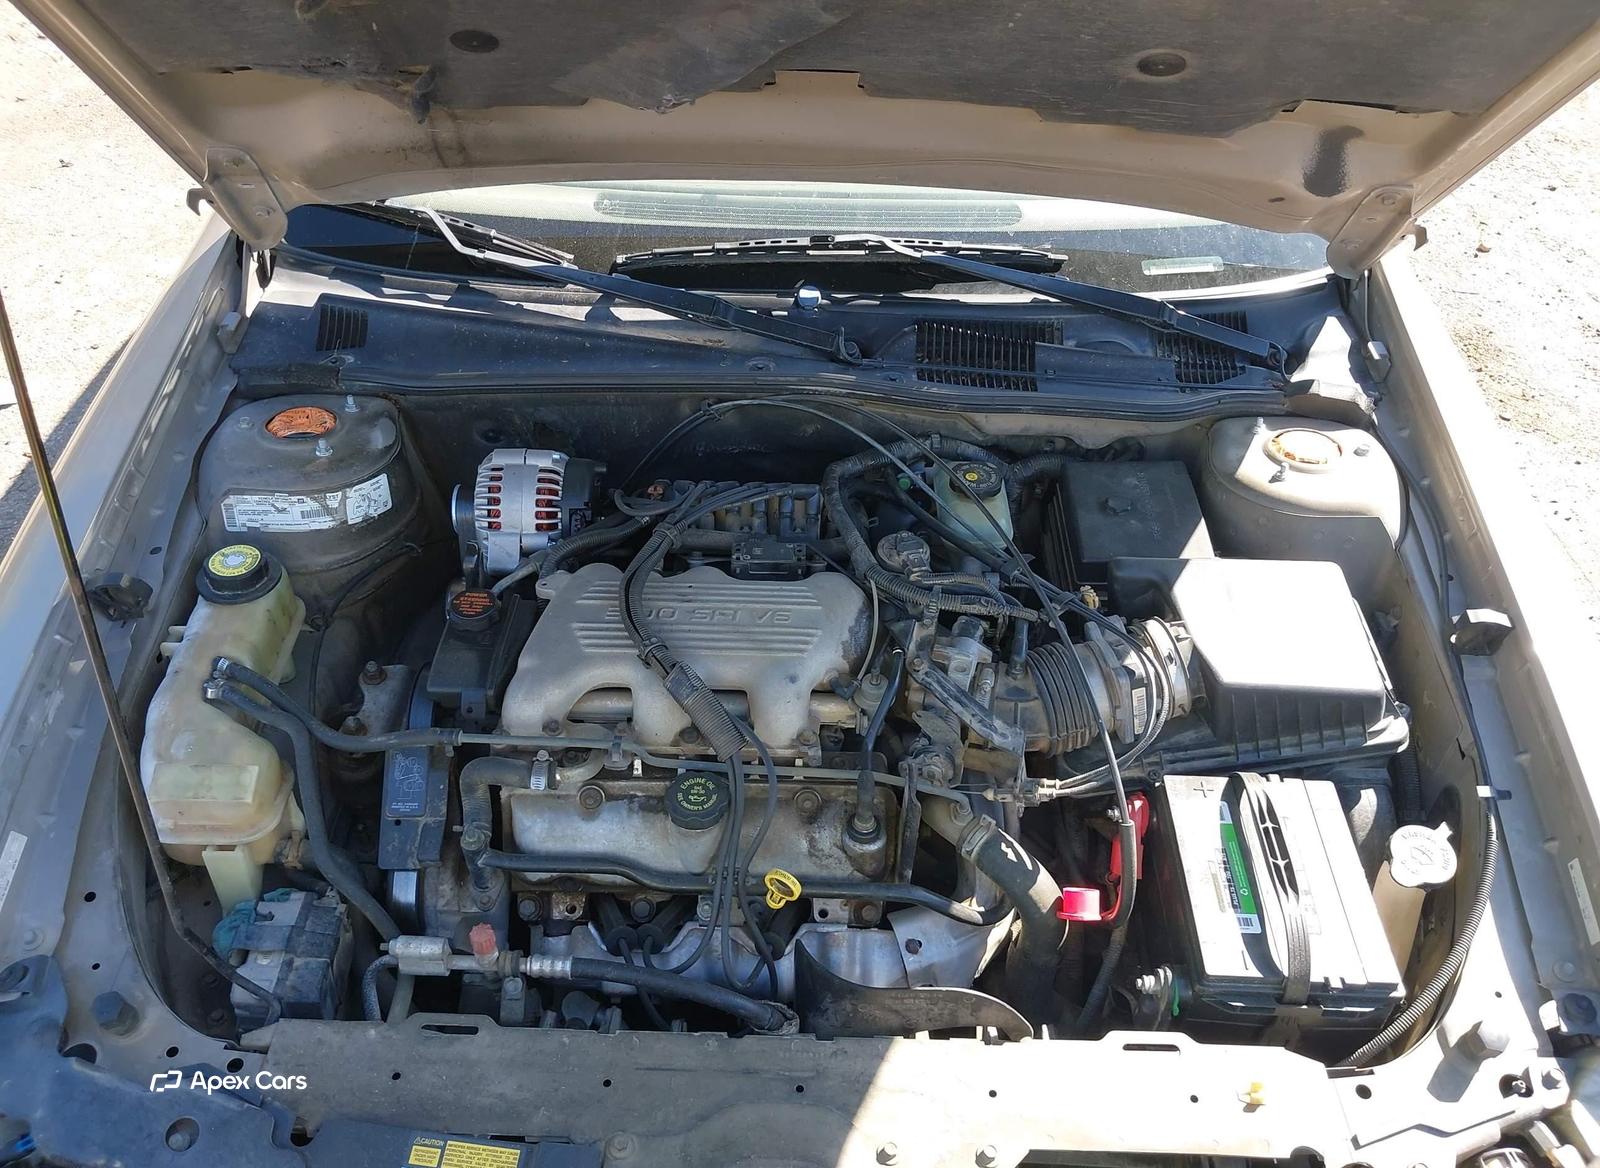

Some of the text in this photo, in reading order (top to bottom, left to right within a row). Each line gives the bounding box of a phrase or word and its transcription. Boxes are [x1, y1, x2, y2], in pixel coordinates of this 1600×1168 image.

[755, 610, 793, 624] V6
[680, 777, 716, 791] ENGINE OIL
[702, 793, 718, 810] MANUAL
[420, 1137, 444, 1146] CAUTION
